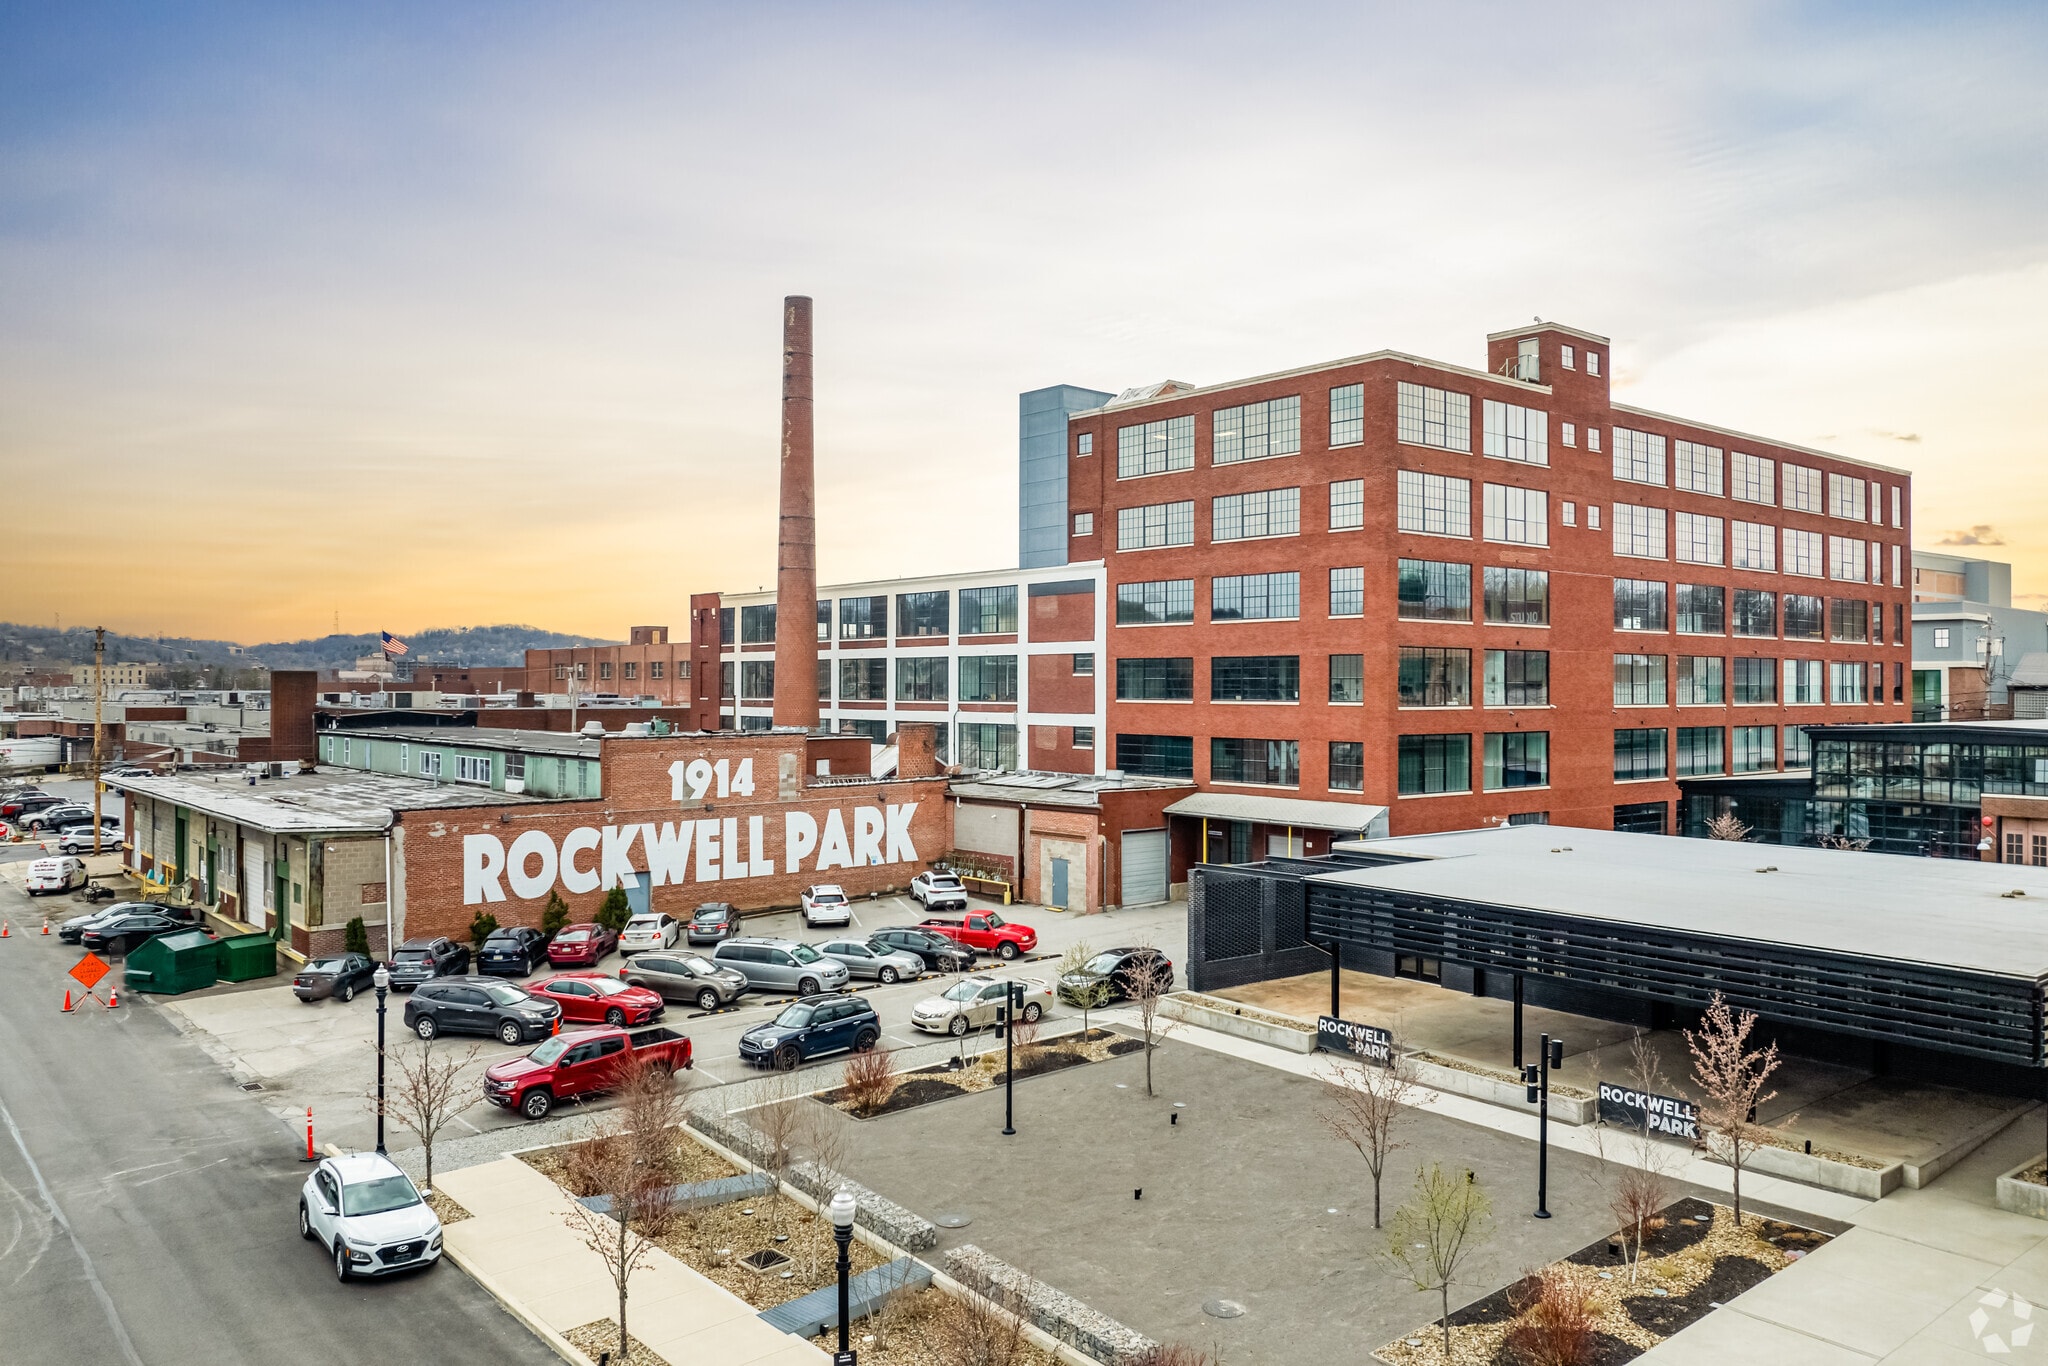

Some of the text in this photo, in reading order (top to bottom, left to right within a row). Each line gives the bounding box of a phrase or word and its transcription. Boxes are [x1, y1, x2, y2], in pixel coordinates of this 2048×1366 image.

[667, 757, 755, 801] 1914
[463, 802, 920, 905] ROCKWELL PARK
[1319, 1018, 1389, 1046] ROCKWELL
[1355, 1040, 1389, 1061] PARK
[1600, 1085, 1697, 1121] ROCKWELL
[1649, 1113, 1697, 1139] PARK
